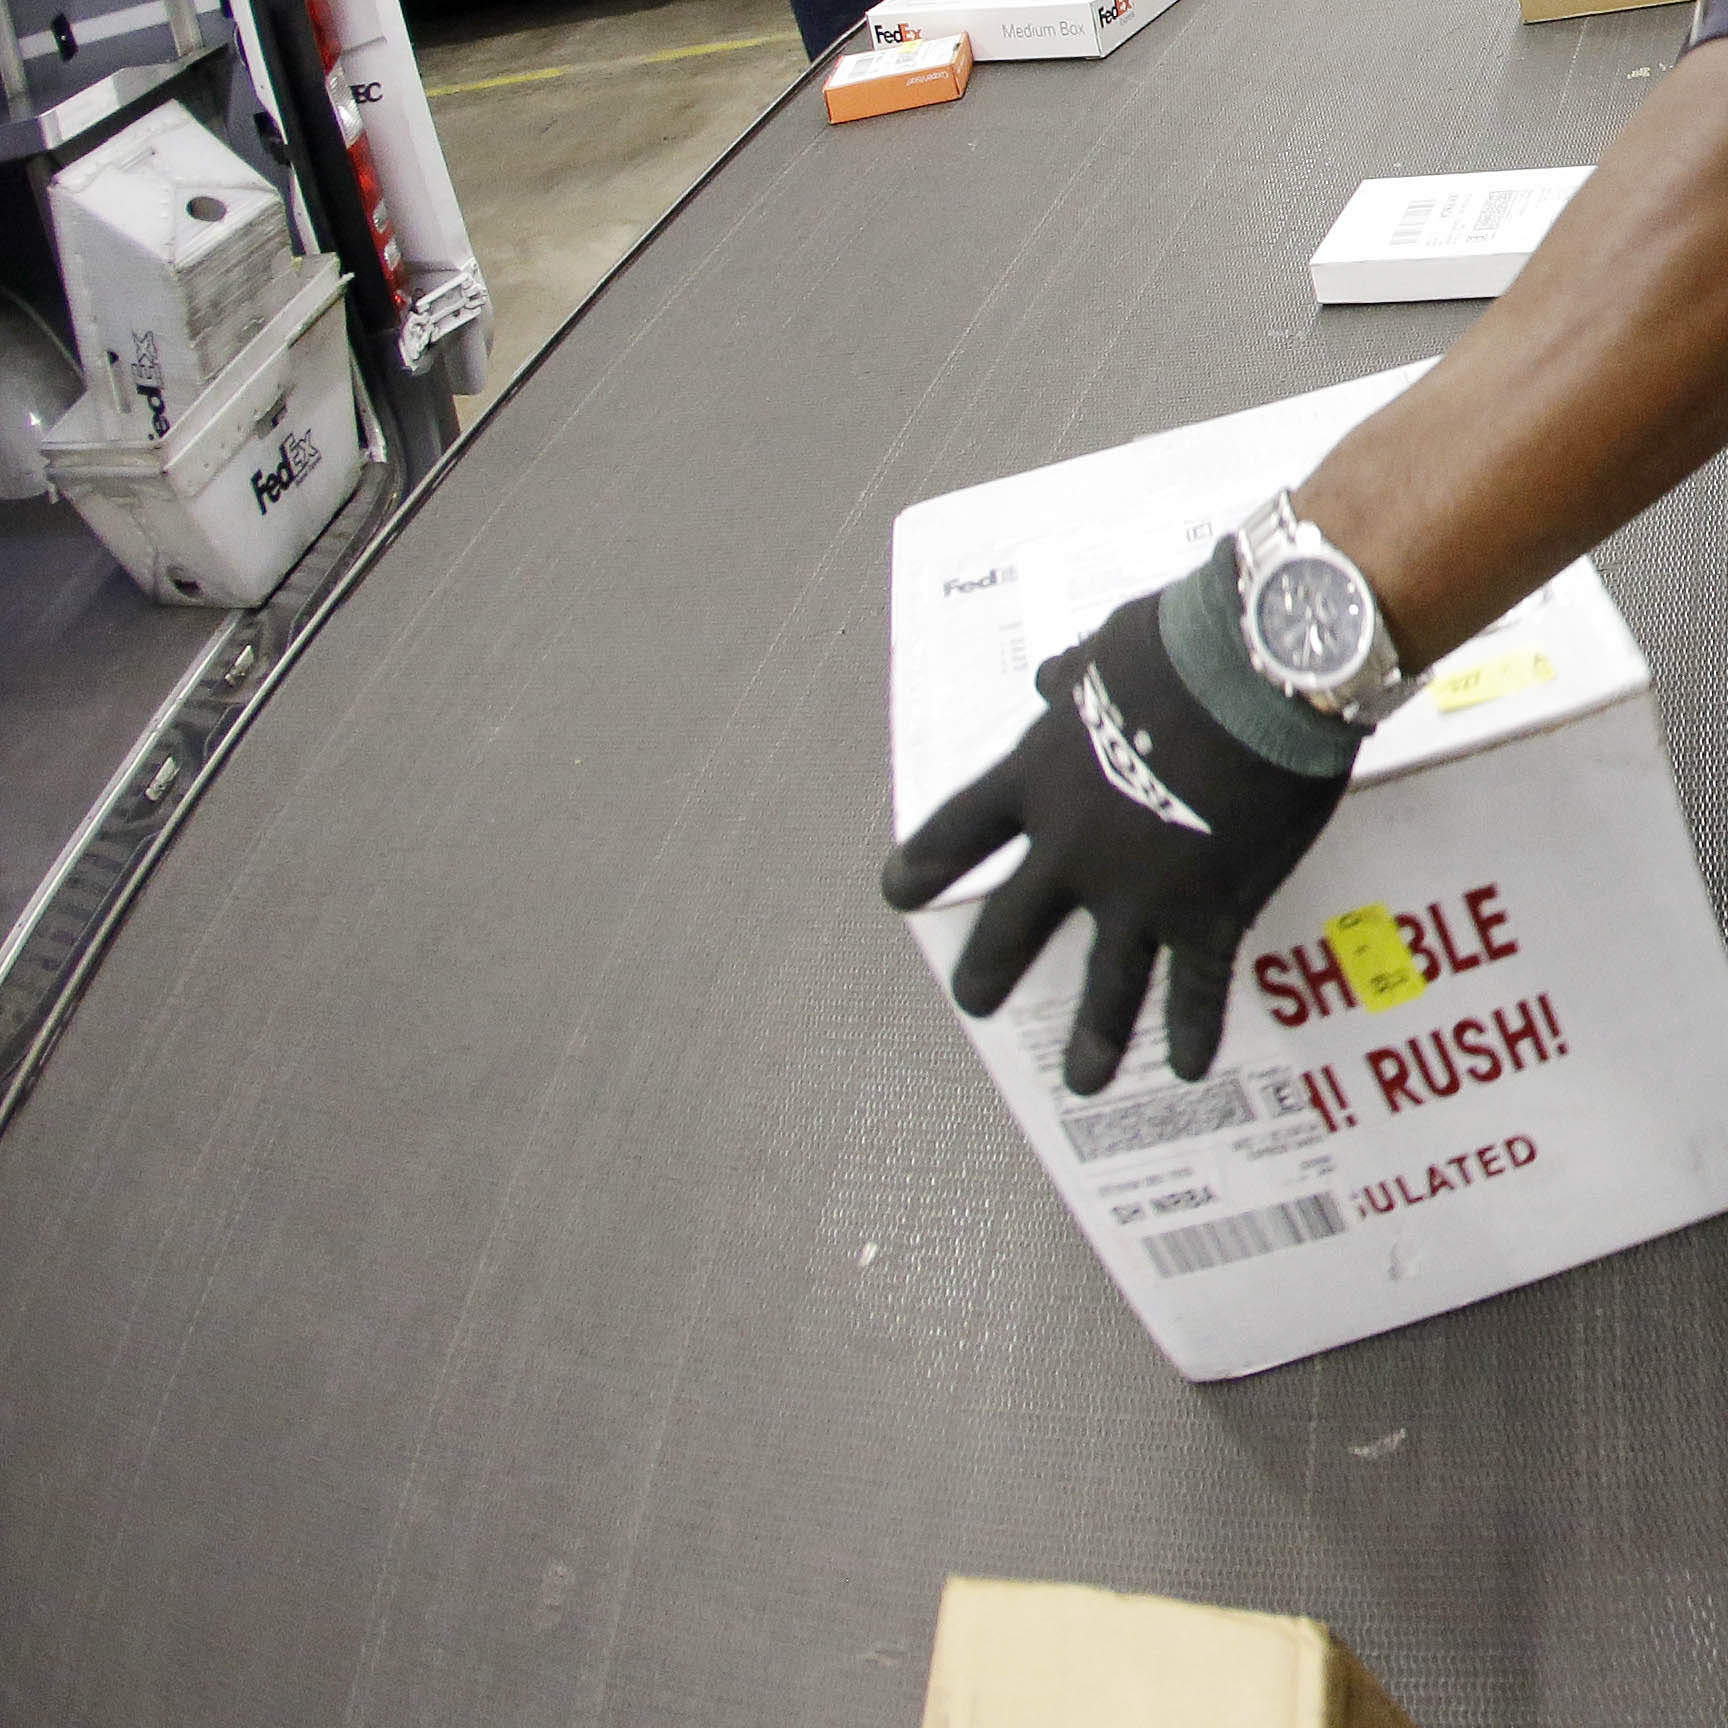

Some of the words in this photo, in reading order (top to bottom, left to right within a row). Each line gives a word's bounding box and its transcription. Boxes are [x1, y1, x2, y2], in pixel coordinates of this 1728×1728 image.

[874, 22, 923, 45] FedEx
[1002, 22, 1056, 39] Medium
[1059, 20, 1087, 37] Box
[131, 329, 171, 441] edEx
[249, 428, 322, 516] FedEx
[1366, 991, 1570, 1114] RUSH!
